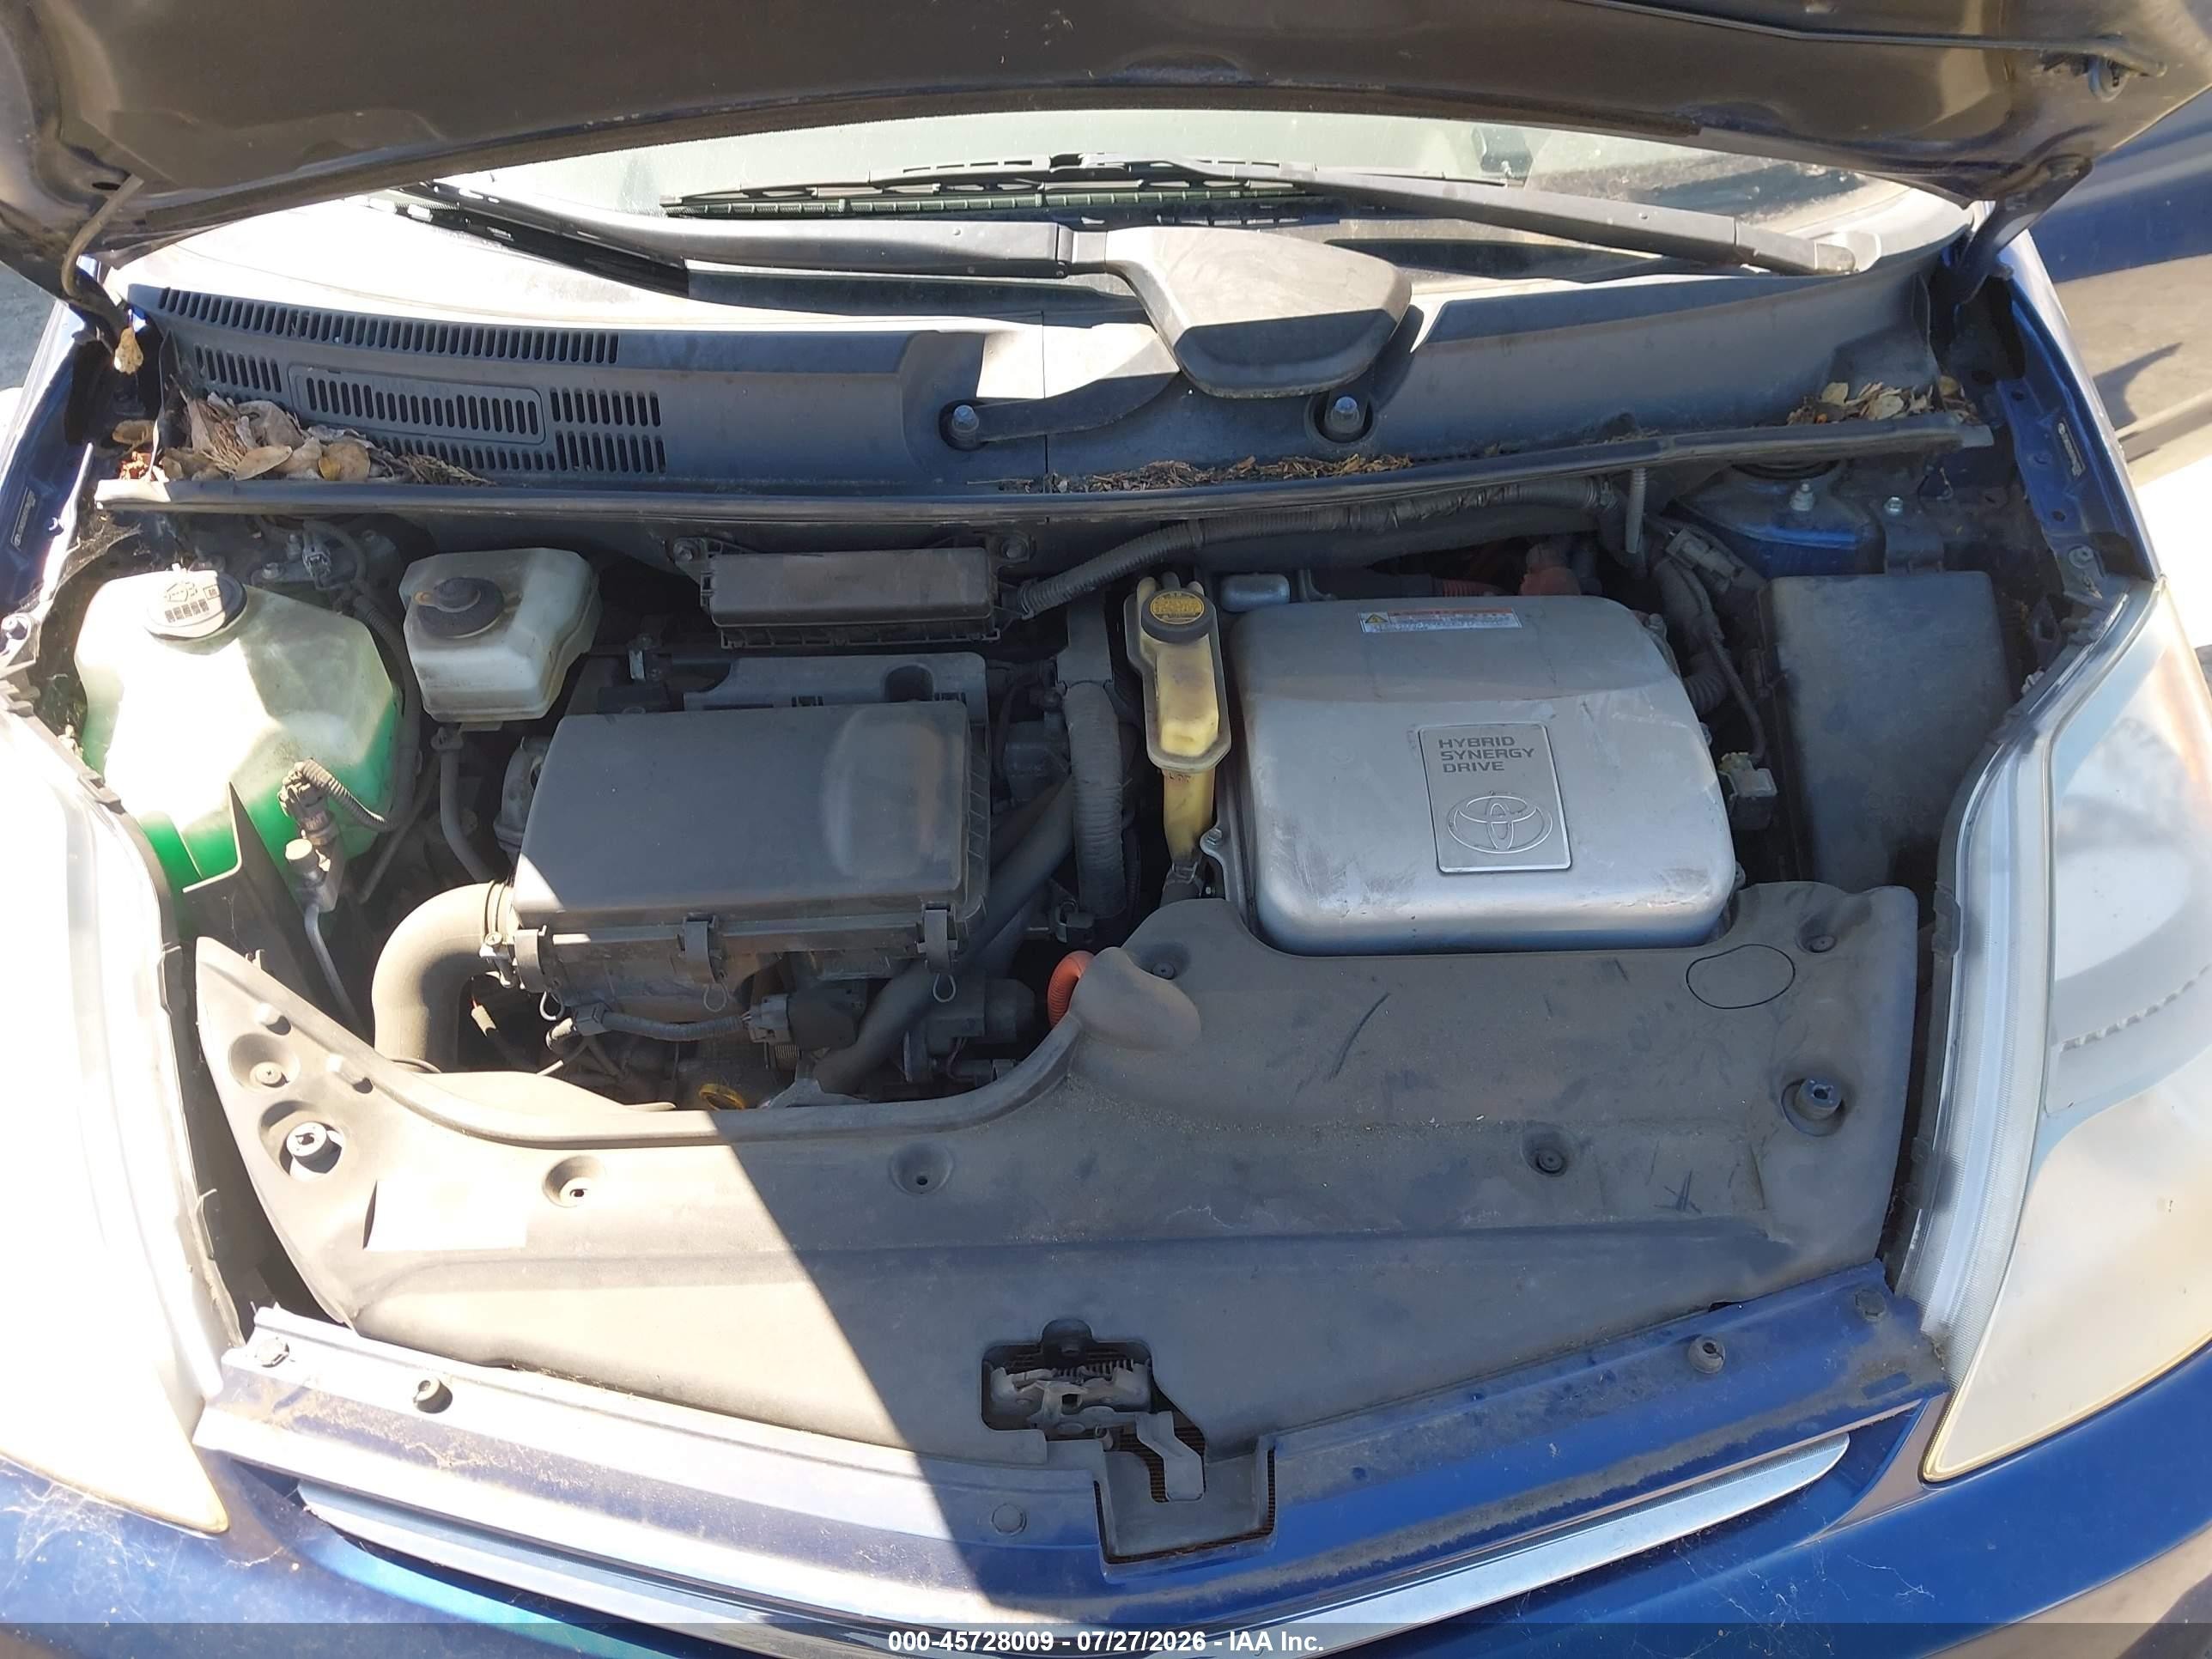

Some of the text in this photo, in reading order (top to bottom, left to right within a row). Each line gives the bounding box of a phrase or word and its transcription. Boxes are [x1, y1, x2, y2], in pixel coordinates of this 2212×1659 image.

[1437, 736, 1516, 749] HYBRID
[1440, 748, 1534, 761] SYNERGY
[1443, 761, 1505, 774] DRIVE
